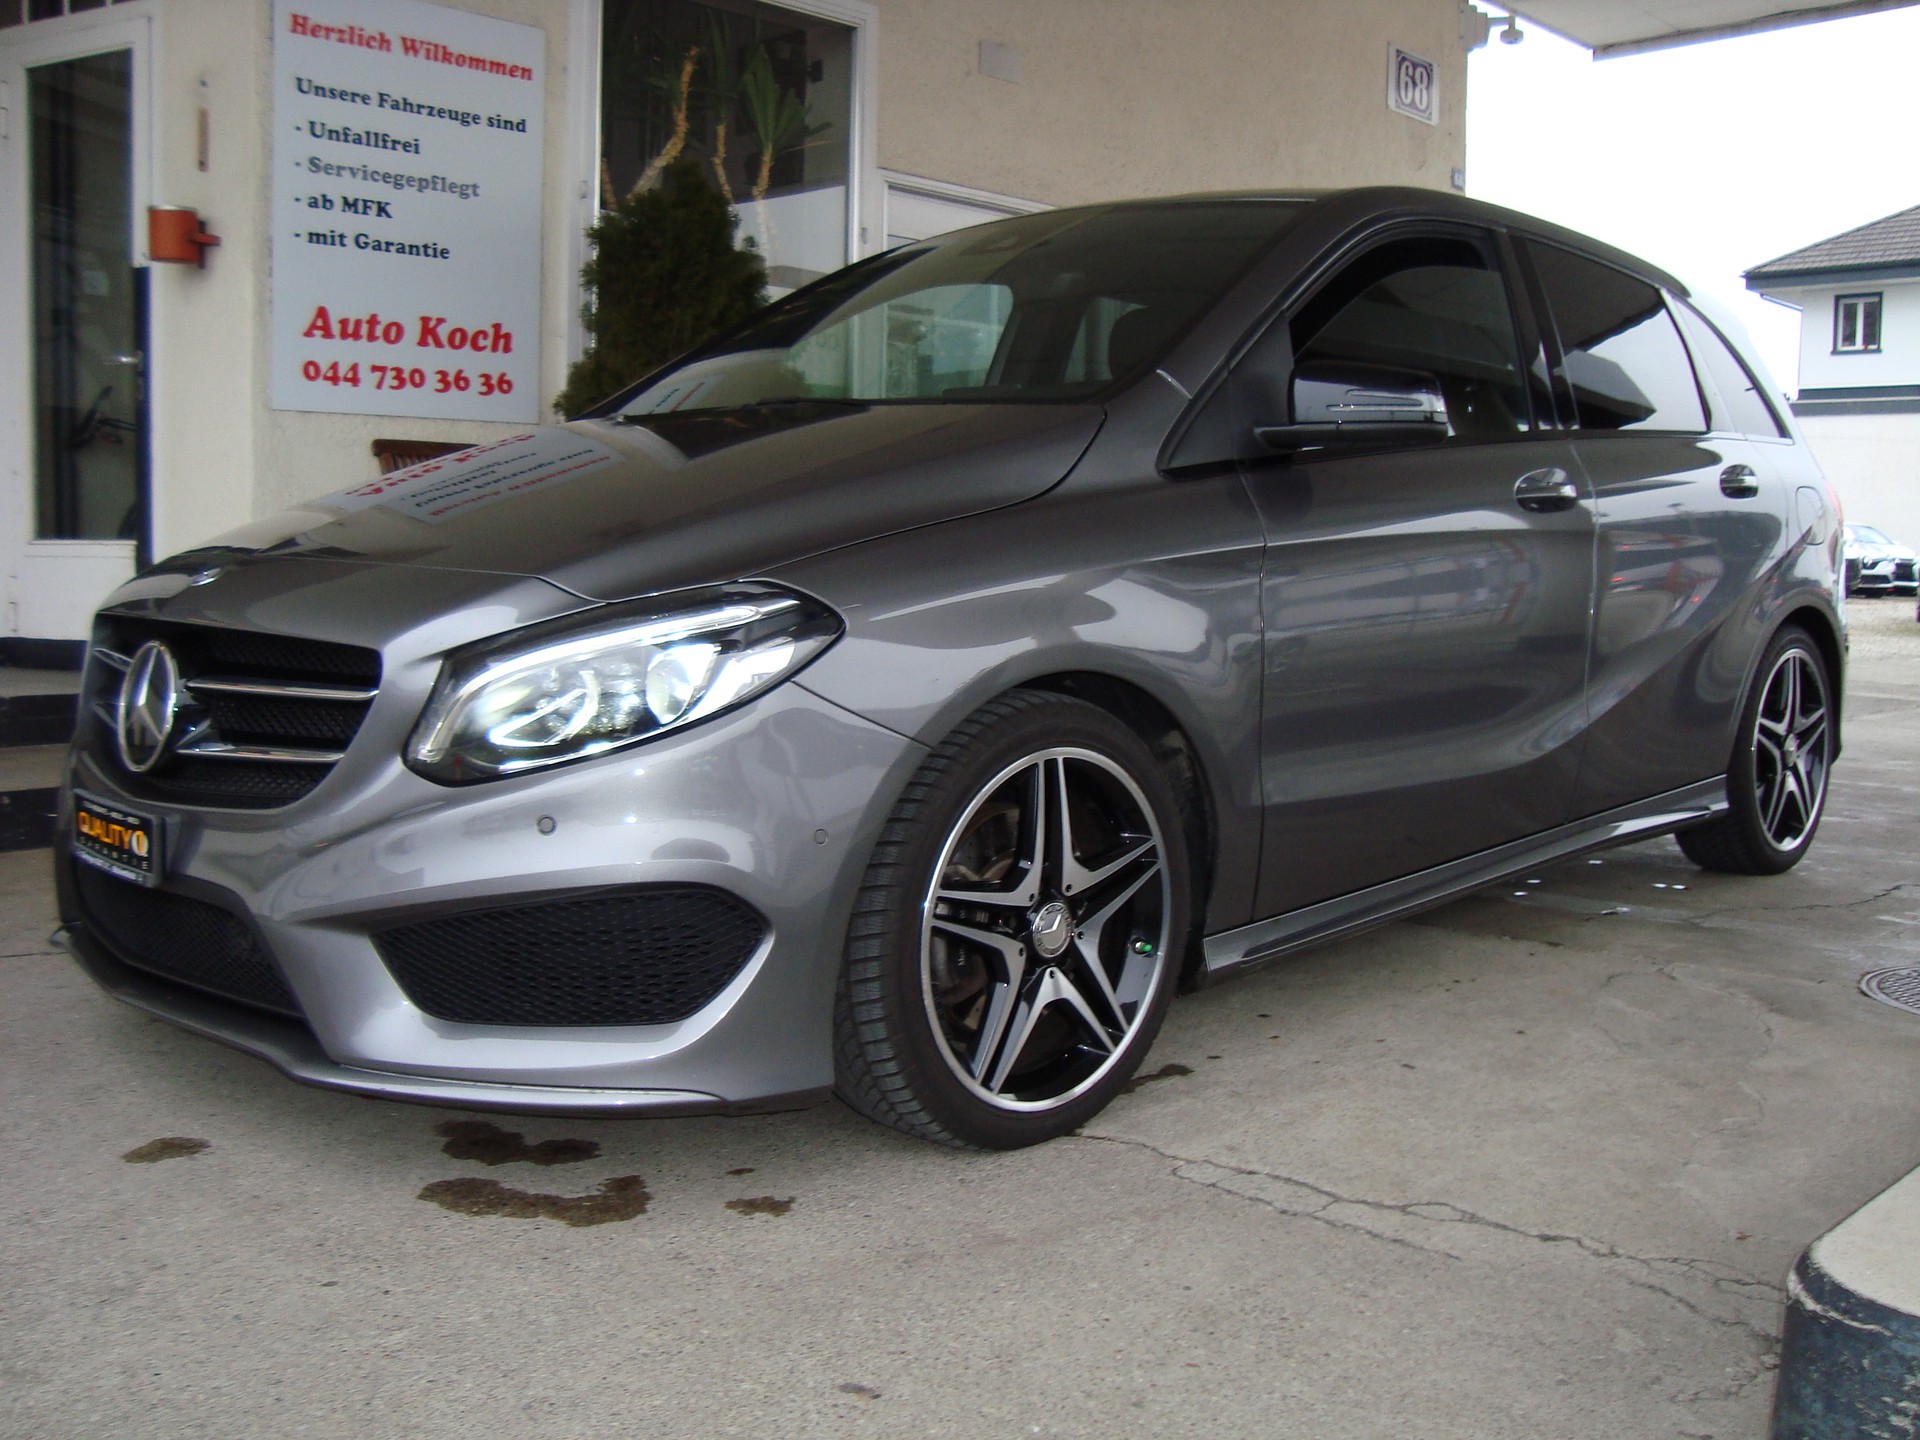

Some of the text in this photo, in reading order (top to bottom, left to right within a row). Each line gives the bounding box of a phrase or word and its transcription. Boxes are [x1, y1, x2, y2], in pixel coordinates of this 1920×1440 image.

[290, 13, 533, 80] Herzlich Wilkommen
[295, 77, 527, 133] Unsere Fahrzeuge sind
[1399, 60, 1429, 110] 68
[308, 121, 420, 154] Unfallfrei
[308, 156, 480, 199] Servicegepflegt
[308, 194, 393, 218] ab MFK
[308, 230, 450, 259] mit Garantie
[303, 306, 513, 353] Auto Koch
[303, 360, 514, 396] 044 730 36 36
